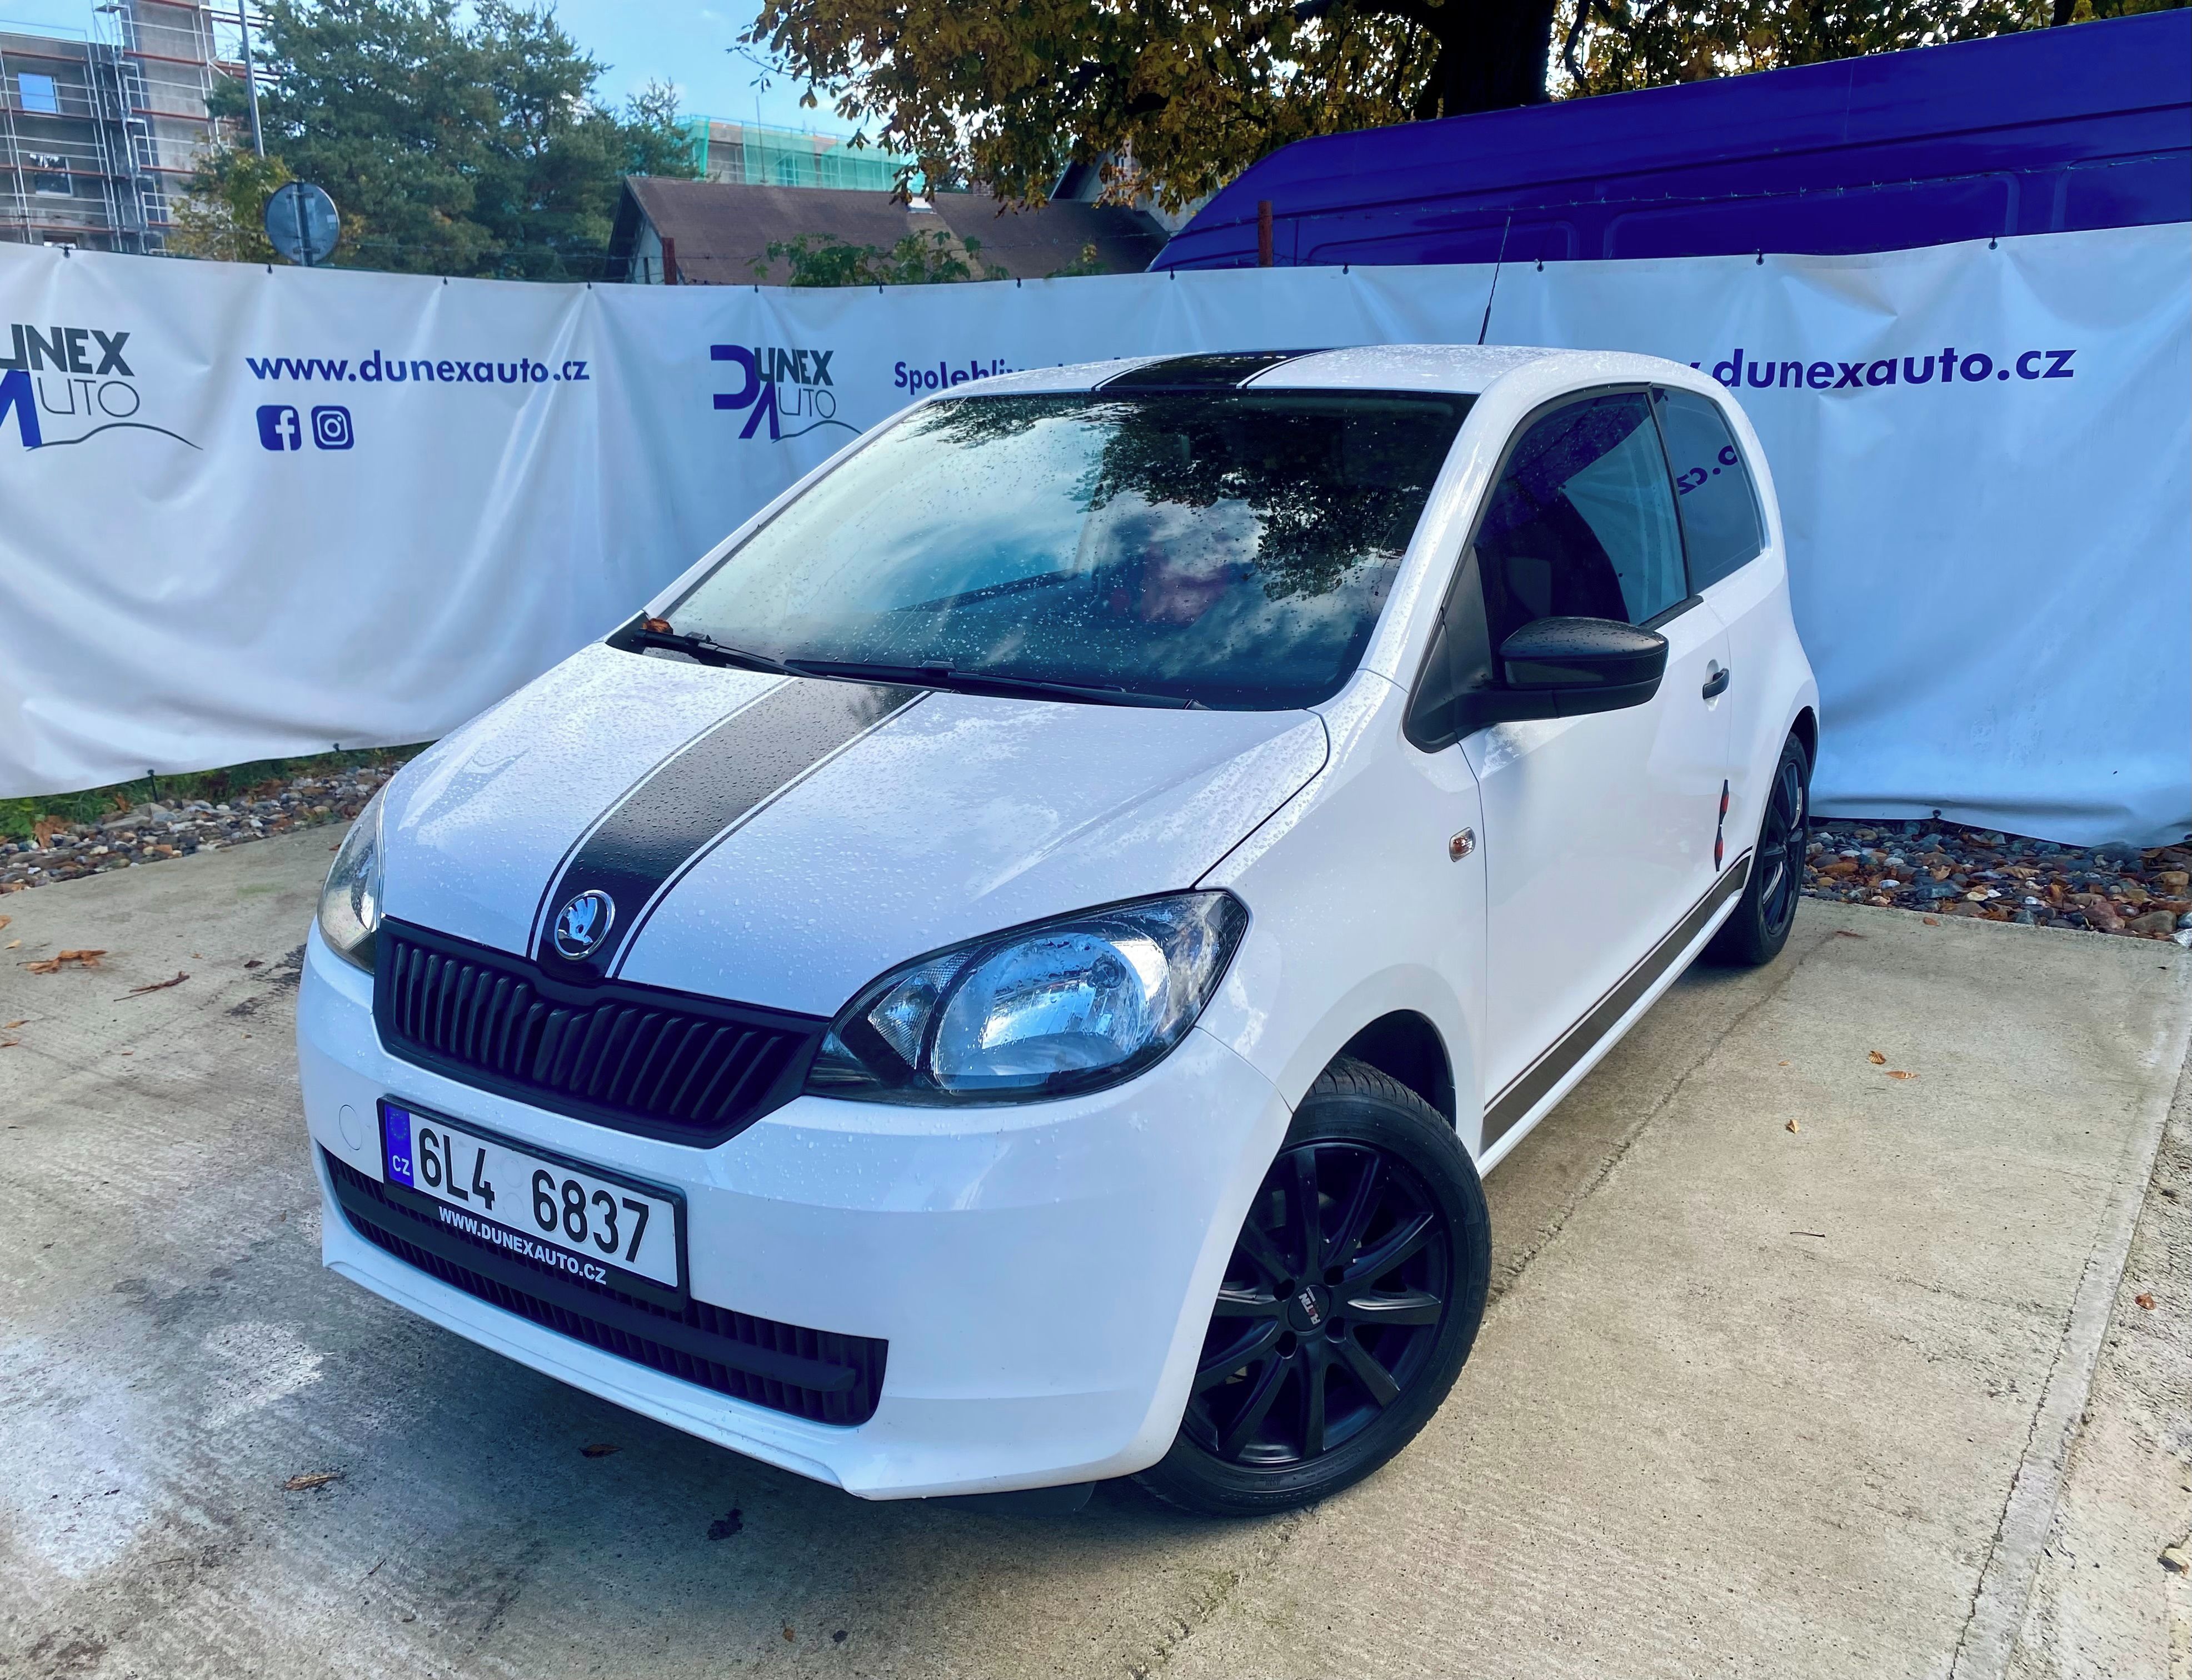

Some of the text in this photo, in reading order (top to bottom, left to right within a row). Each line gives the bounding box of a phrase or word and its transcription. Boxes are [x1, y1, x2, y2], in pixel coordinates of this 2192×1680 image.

[0, 324, 135, 377] UNEX
[246, 350, 590, 383] www.dunexauto.cz
[710, 344, 834, 409] DUNEX
[1689, 348, 2077, 389] dunexauto.cz
[392, 1155, 411, 1177] CZ
[419, 1127, 650, 1263] 6L4 6837
[439, 1206, 607, 1285] WWW.DUNEXAUTO.CZ
